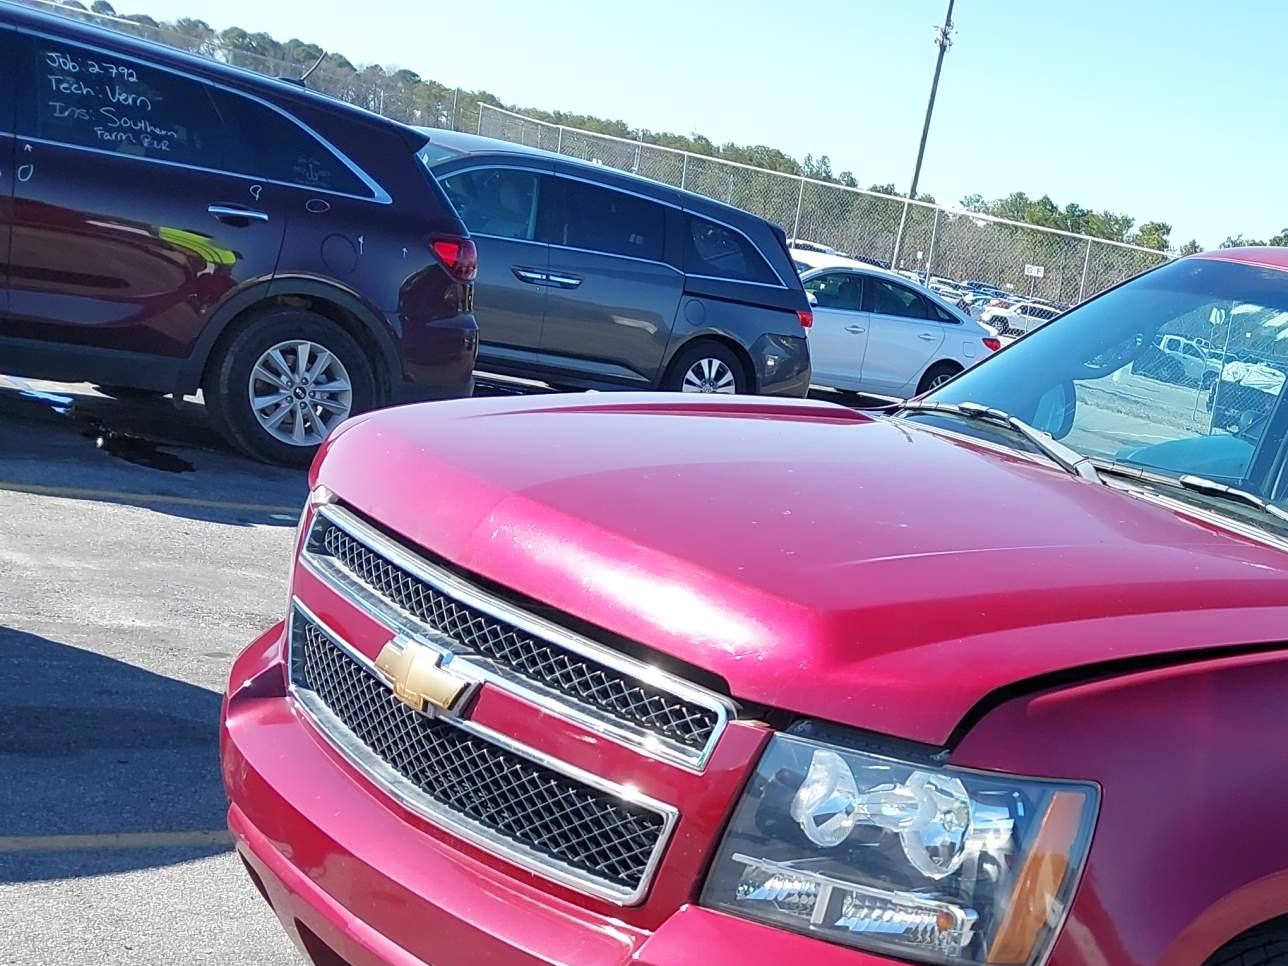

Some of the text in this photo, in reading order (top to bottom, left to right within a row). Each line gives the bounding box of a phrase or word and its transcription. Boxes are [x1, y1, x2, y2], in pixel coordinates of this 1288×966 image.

[87, 60, 139, 82] 2792
[105, 85, 152, 112] Vern
[99, 106, 178, 139] Southern
[93, 126, 137, 144] Farm
